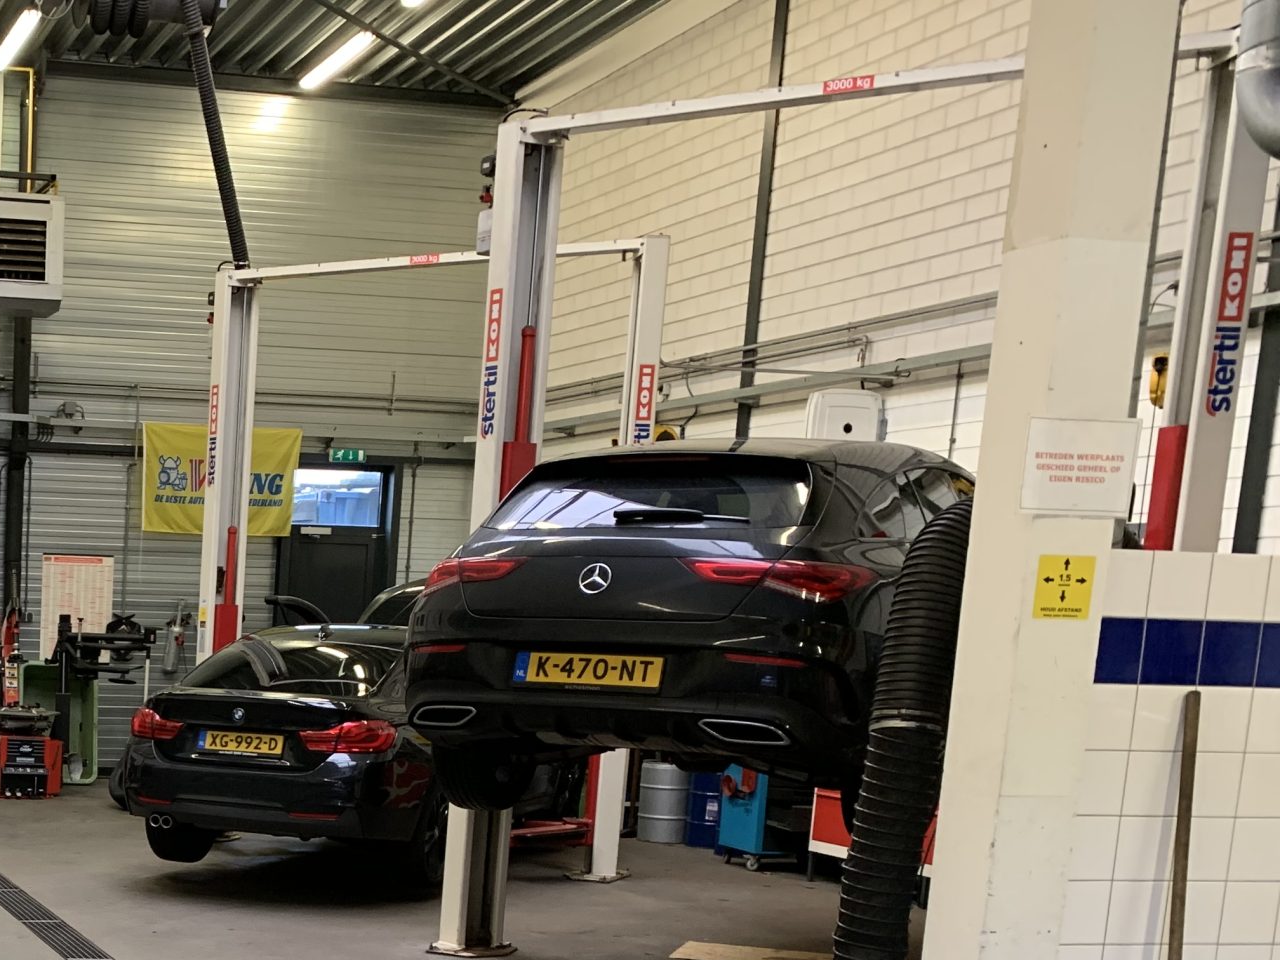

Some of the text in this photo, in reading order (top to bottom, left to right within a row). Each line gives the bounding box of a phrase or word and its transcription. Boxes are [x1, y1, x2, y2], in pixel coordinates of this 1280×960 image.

[826, 77, 871, 91] 3000 kg
[1205, 237, 1248, 417] stertil KONI
[482, 292, 500, 439] stertil KONI
[638, 367, 652, 418] KONI
[207, 387, 218, 487] stertil KONI
[1035, 451, 1125, 462] BETREDEN WERPLAATS
[1036, 463, 1075, 472] GESCHIED
[1077, 465, 1108, 473] GEHEEL
[1049, 475, 1073, 483] EIGEN
[155, 494, 163, 503] DE
[164, 495, 187, 504] BESTE
[248, 498, 283, 507] EDERLAND
[516, 669, 525, 677] NL
[535, 656, 654, 682] K-470-NT
[209, 733, 278, 751] XG-992-D
